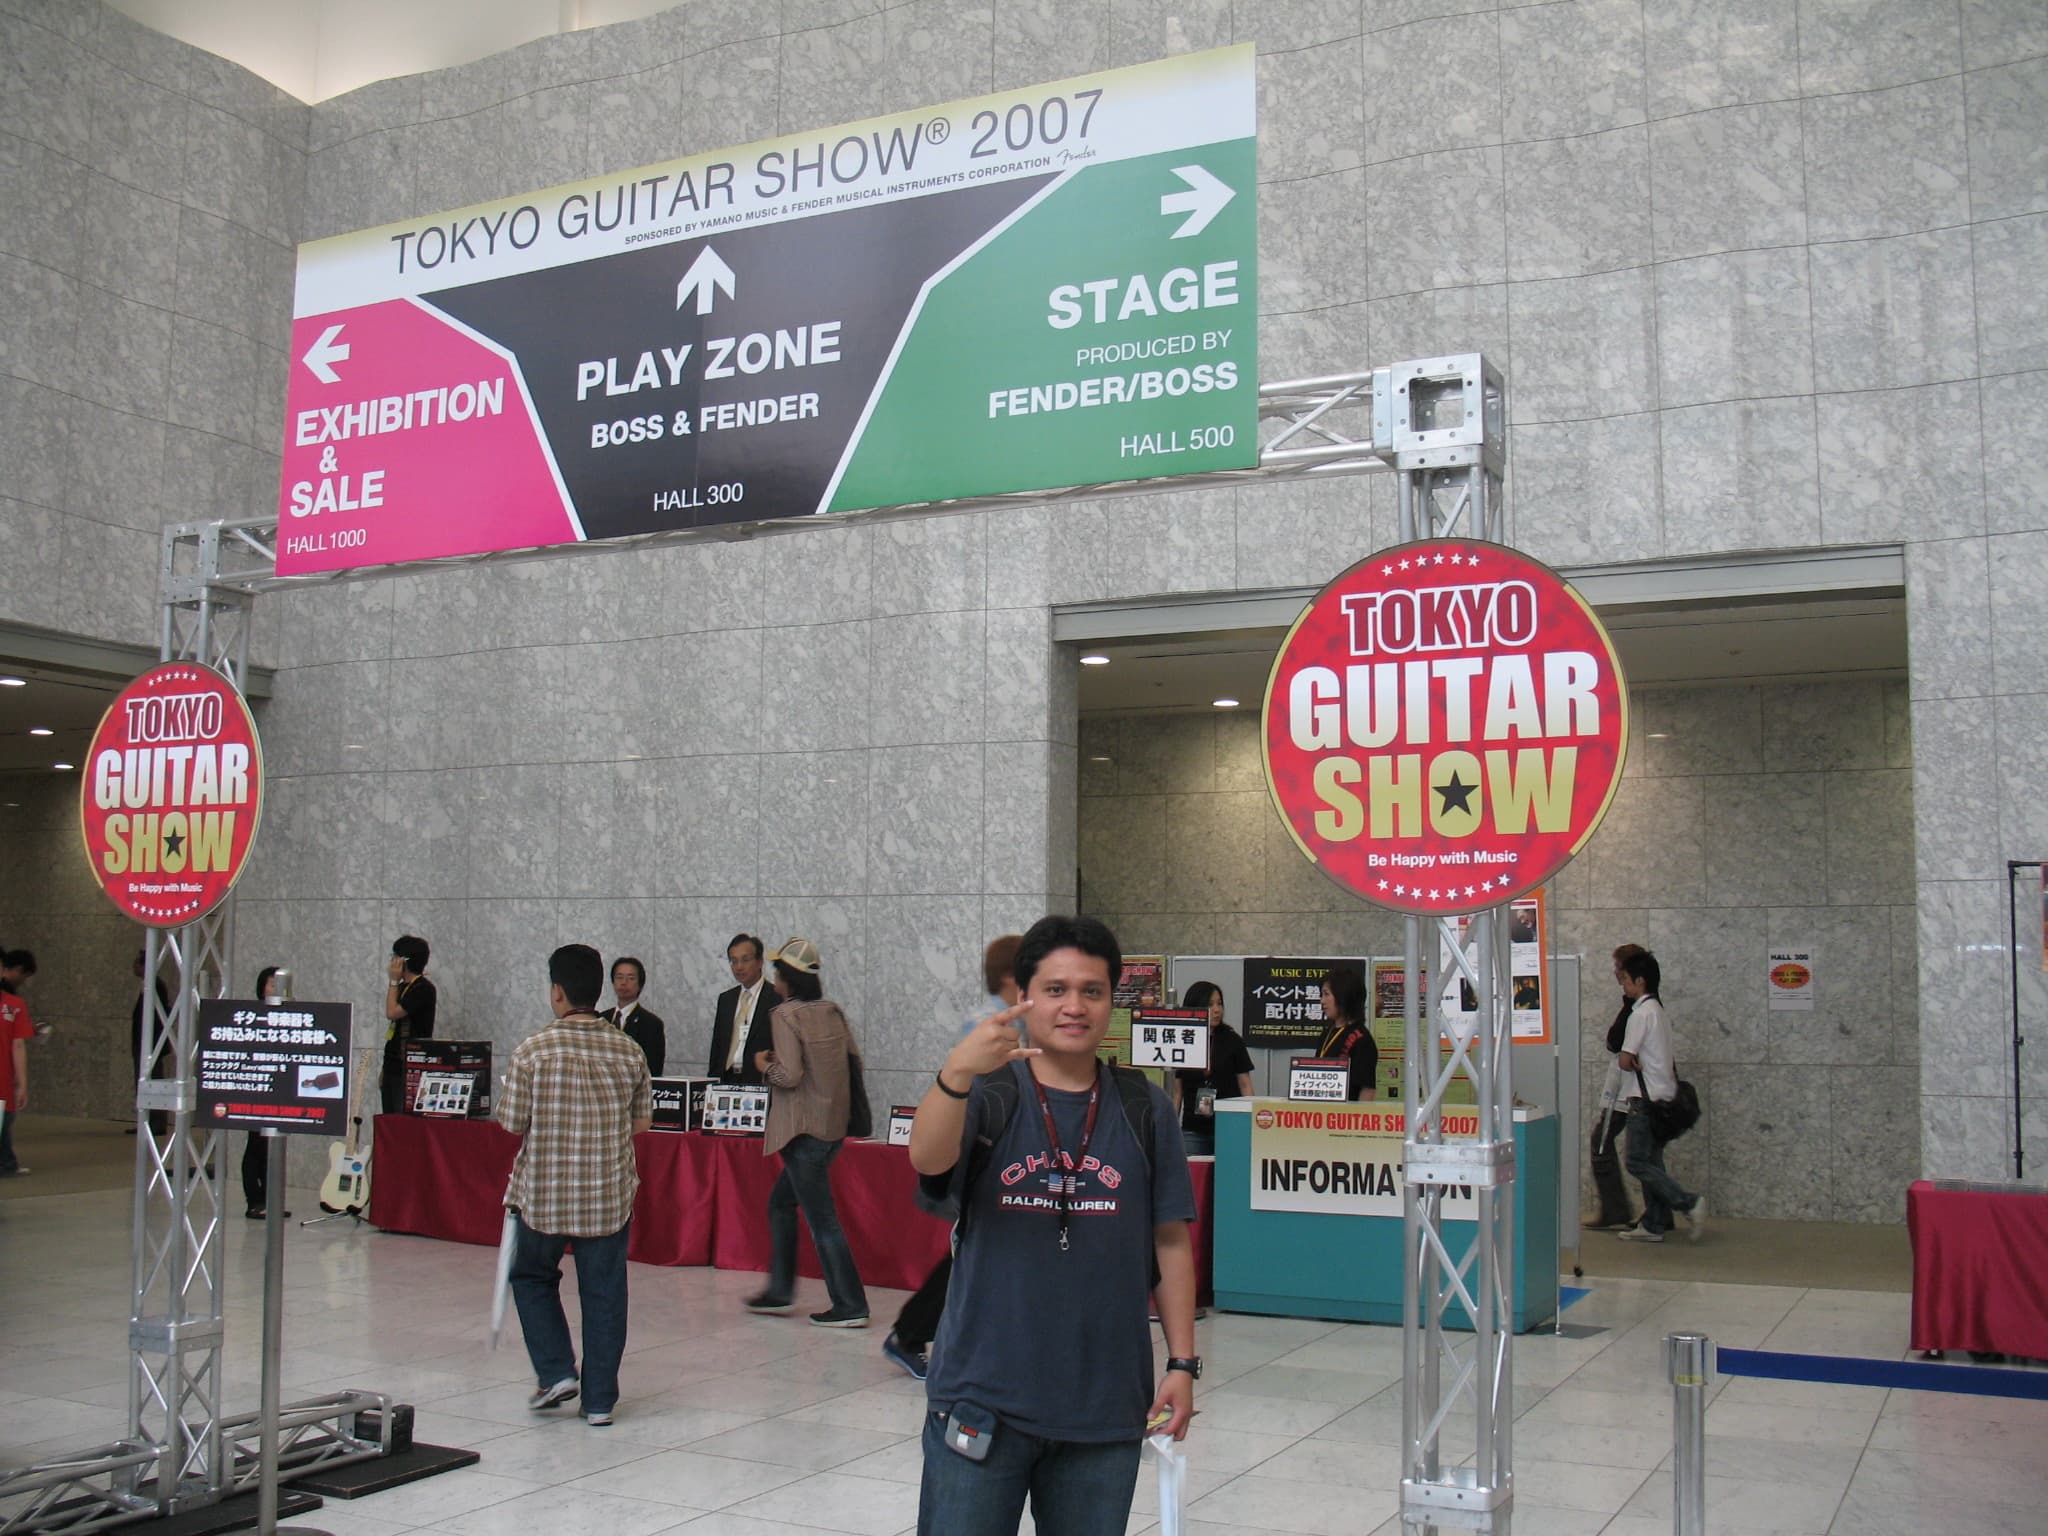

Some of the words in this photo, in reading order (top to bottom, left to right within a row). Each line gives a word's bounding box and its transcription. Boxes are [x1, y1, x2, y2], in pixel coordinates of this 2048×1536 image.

[390, 204, 541, 275] TOKYO
[557, 160, 736, 238] GUITAR
[968, 88, 1105, 160] 2007
[624, 225, 682, 245] SPONSORED
[684, 222, 697, 234] BY
[700, 213, 742, 230] YAMANO
[745, 206, 779, 221] MUSIC
[780, 204, 789, 215] &
[791, 196, 833, 212] FENDER
[836, 187, 883, 204] MUSICAL
[886, 171, 965, 195] INSTRUMENTS
[968, 156, 1051, 181] CORPORATION
[1056, 145, 1097, 166] Fender
[1047, 259, 1240, 330] STAGE
[576, 343, 694, 402] PLAY
[704, 320, 842, 381] ZONE
[1075, 333, 1197, 368] PRODUCED
[1202, 328, 1233, 352] BY
[987, 361, 1239, 420] FENDER/BOSS
[295, 377, 505, 447] EXHIBITION
[590, 412, 664, 450] BOSS
[672, 409, 693, 437] &
[700, 391, 820, 434] FENDER
[318, 444, 339, 475] &
[1119, 430, 1186, 458] HALL
[1189, 424, 1235, 450] 500
[289, 469, 386, 519] SALE
[652, 486, 705, 513] HALL
[706, 481, 744, 507] 300
[286, 530, 329, 555] HALL
[330, 528, 367, 551] 1000
[1340, 579, 1538, 656] TOKYO
[126, 692, 223, 743] TOKYO
[1289, 651, 1600, 752] GUITAR
[95, 743, 249, 810] GUITAR
[1312, 746, 1578, 842] SHOW
[103, 811, 236, 874] SHOW
[1368, 853, 1387, 867] Be
[1391, 852, 1436, 869] Happy
[1439, 851, 1470, 865] with
[1473, 850, 1518, 864] Music
[128, 882, 139, 893] Be
[140, 882, 163, 895] Happy
[163, 882, 179, 893] with
[180, 882, 203, 893] Music
[1270, 968, 1302, 978] MUSIC
[1252, 985, 1321, 1001] イベント整
[1265, 1002, 1328, 1020] 配付場
[1142, 1027, 1196, 1045] 関係者
[1152, 1047, 1186, 1063] 入口
[1294, 1080, 1343, 1089] ライブイベント
[1299, 1072, 1339, 1081] HALL500
[1275, 1110, 1323, 1130] TOKYO
[1326, 1112, 1381, 1132] GUITAR
[1440, 1116, 1479, 1135] 2007
[1000, 1151, 1122, 1189] CHAPS
[1260, 1158, 1473, 1201] INFORMA
[1002, 1195, 1053, 1209] RALPH
